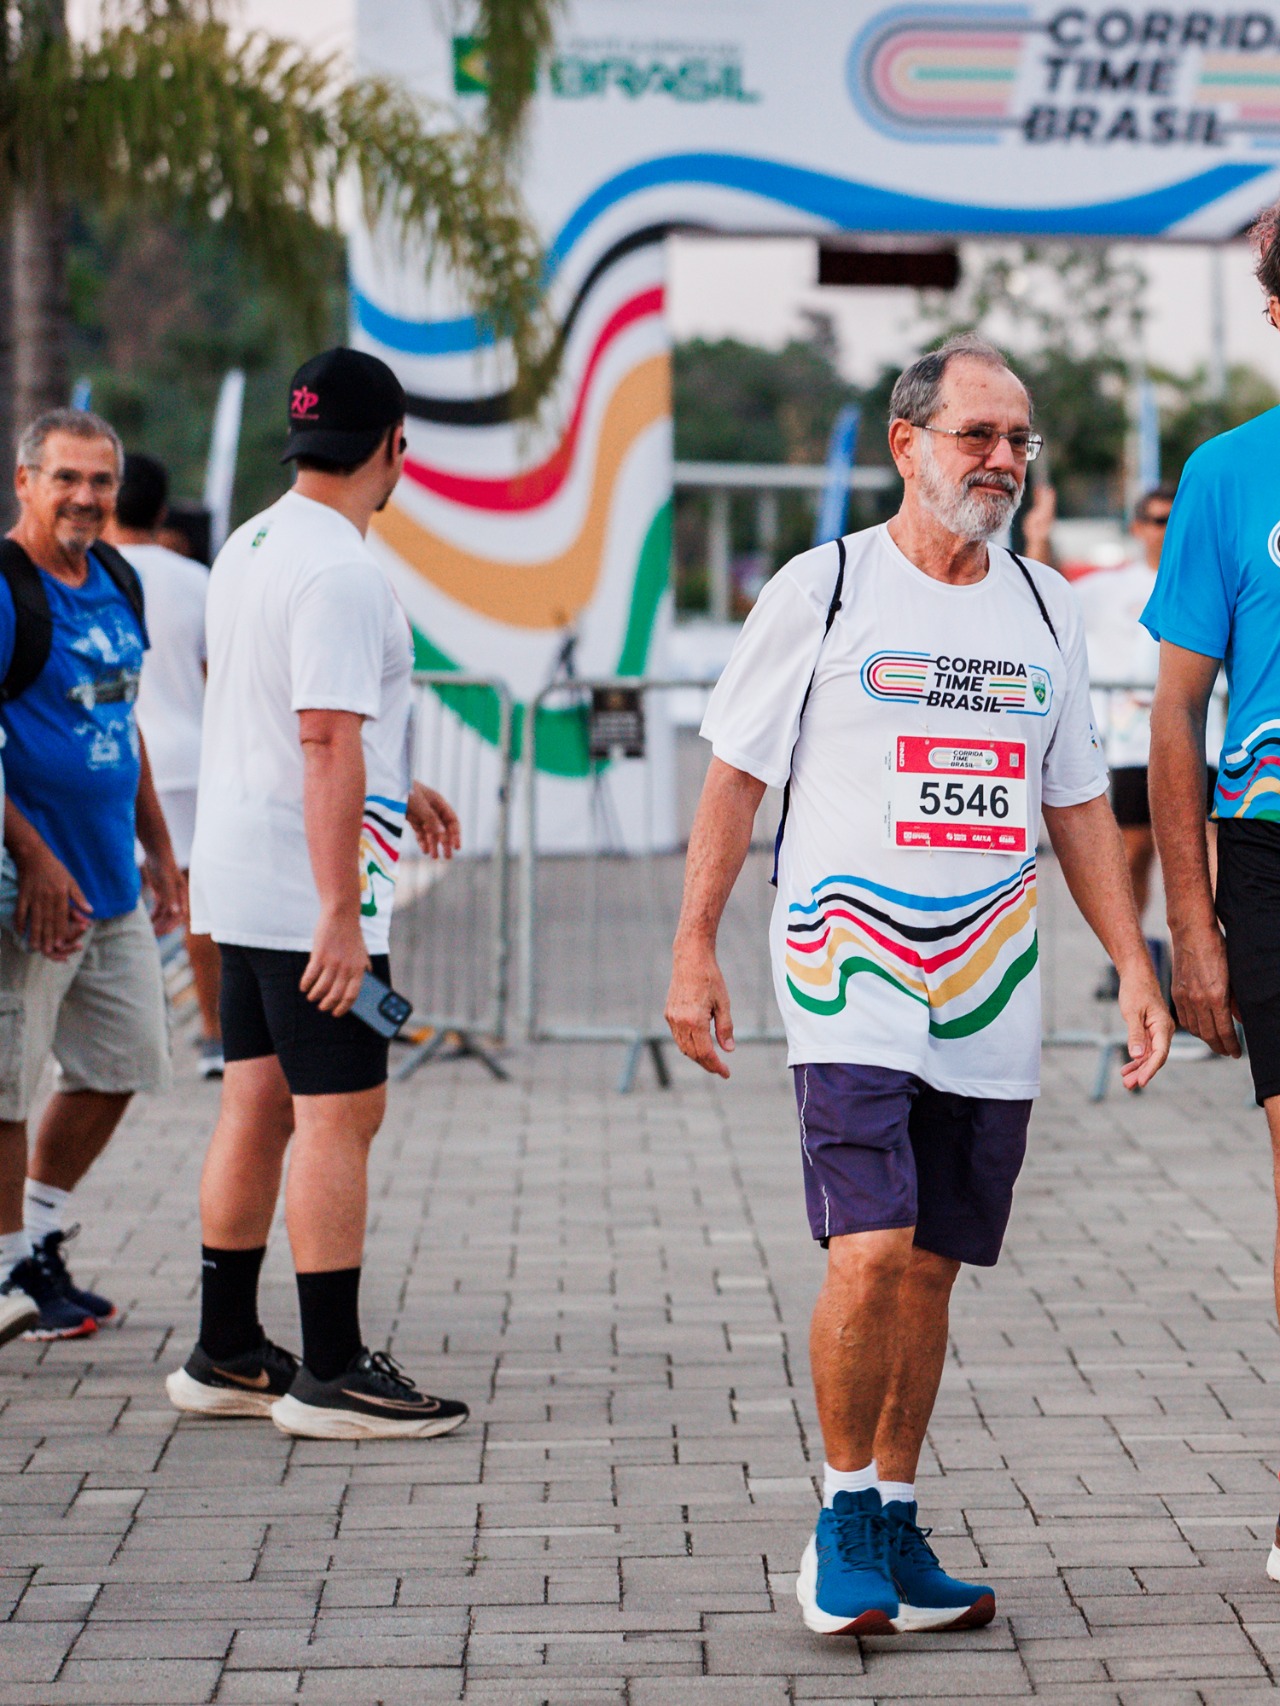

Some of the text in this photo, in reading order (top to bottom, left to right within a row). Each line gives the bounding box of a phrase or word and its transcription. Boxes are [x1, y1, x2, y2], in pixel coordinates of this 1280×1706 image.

[1045, 57, 1178, 96] TIME
[1024, 105, 1224, 144] BRASIL
[936, 655, 1027, 678] CORRIDA
[934, 672, 984, 692] TIME
[926, 690, 1001, 713] BRASIL
[919, 781, 1009, 819] 5546
